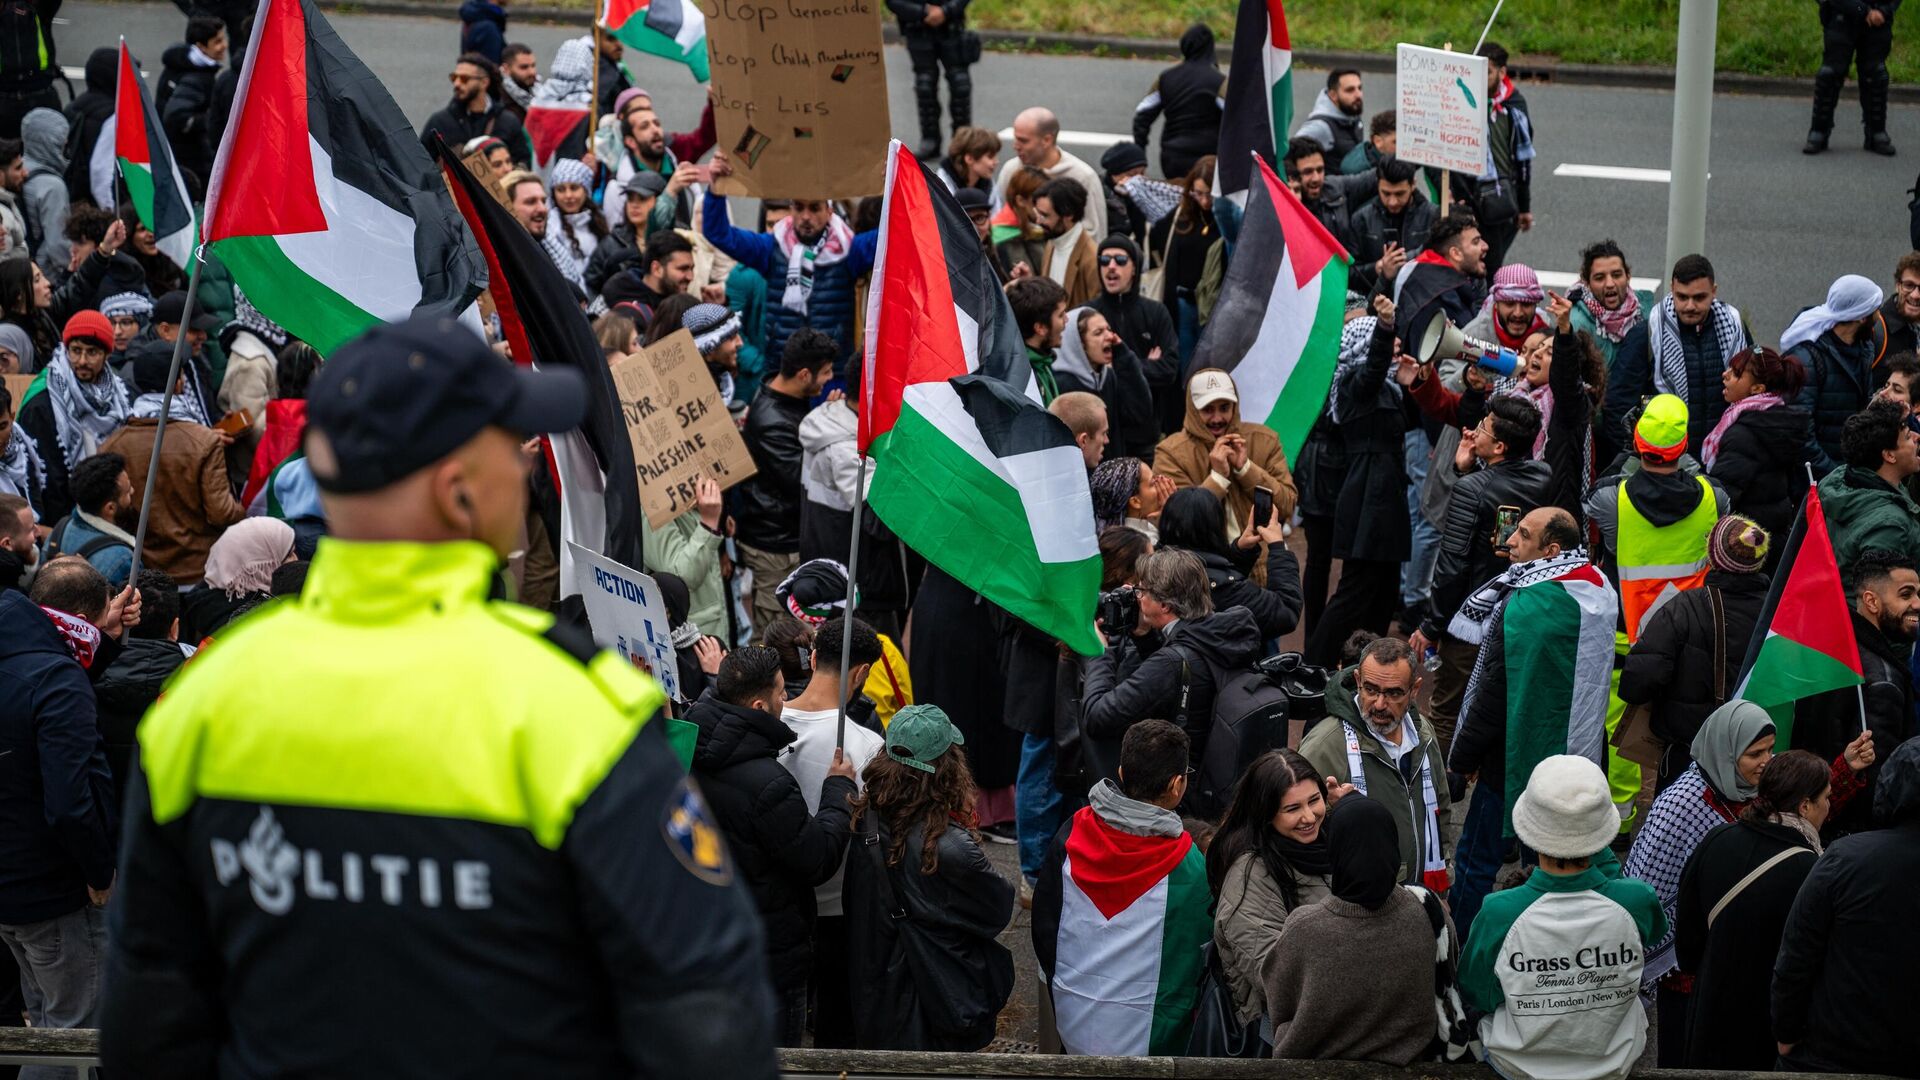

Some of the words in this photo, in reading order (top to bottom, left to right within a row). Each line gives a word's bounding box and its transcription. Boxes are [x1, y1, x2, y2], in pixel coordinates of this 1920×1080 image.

[1440, 131, 1481, 147] HOSPITAL
[1464, 333, 1500, 353] MARCH
[1207, 375, 1221, 390] A
[676, 397, 708, 429] SEA
[594, 566, 647, 607] ACTION
[209, 805, 493, 916] POLITIE
[1509, 952, 1571, 972] Grass
[1575, 942, 1639, 969] Club.
[1535, 973, 1575, 988] Tennis
[1577, 971, 1619, 989] Player
[1517, 1000, 1540, 1010] Paris
[1548, 997, 1584, 1009] London
[1592, 992, 1613, 1004] New
[1615, 988, 1637, 999] York.
